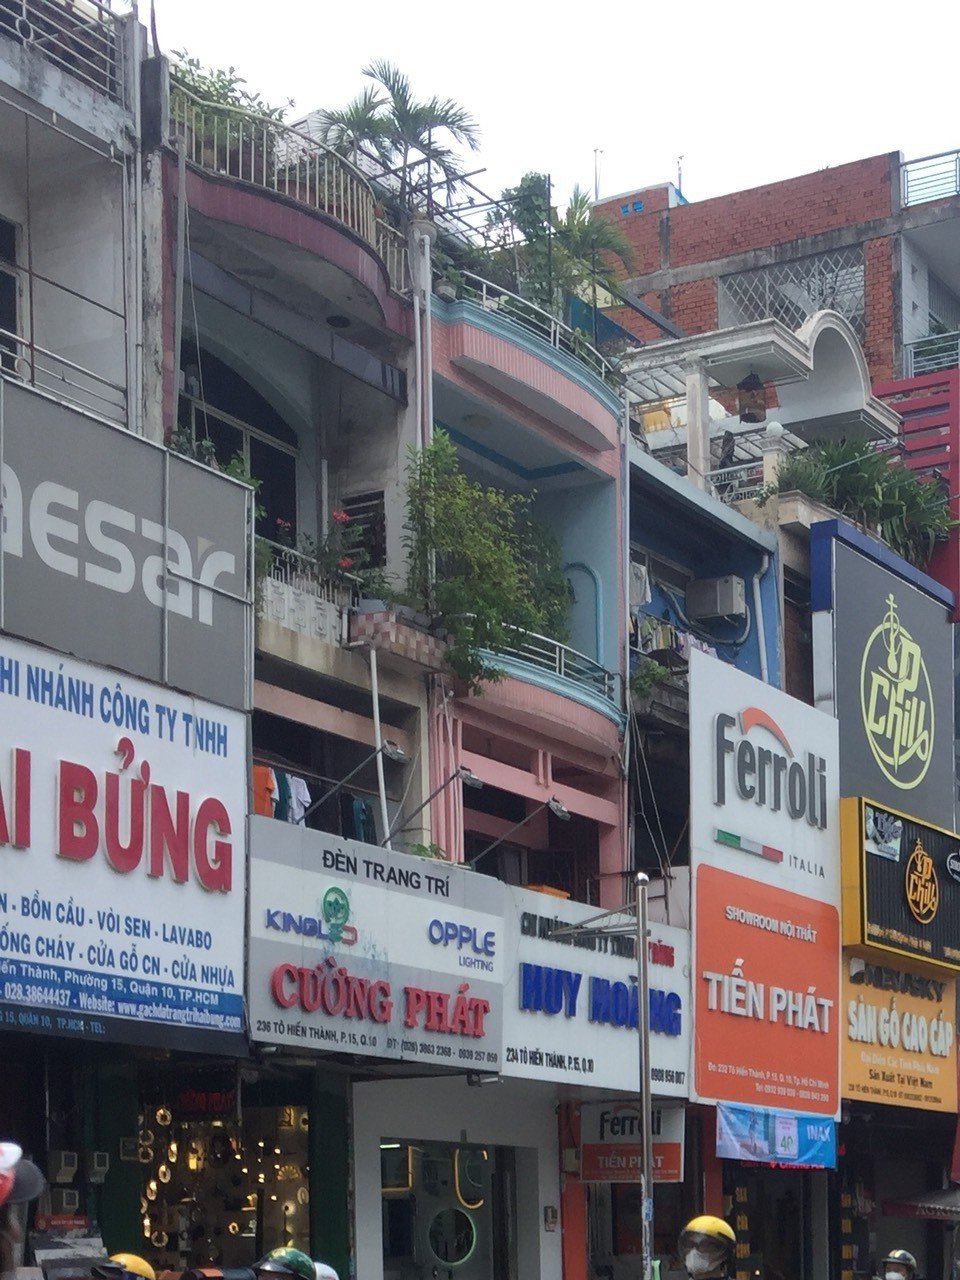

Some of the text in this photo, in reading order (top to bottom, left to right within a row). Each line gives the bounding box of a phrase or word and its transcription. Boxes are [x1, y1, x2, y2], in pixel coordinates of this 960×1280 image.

[27, 663, 94, 719] NHÁNH
[100, 683, 150, 735] CÔNG
[156, 704, 177, 742] TY
[183, 712, 228, 757] TNHH
[0, 737, 233, 892] I BỬNG
[322, 848, 450, 897] ĐÈN TRANG TRÍ
[789, 854, 825, 878] ITALIA
[21, 890, 52, 921] BỒN
[56, 896, 85, 927] CẦU
[98, 907, 120, 934] VÒI
[125, 915, 151, 939] SEN
[162, 923, 212, 950] LAVABO
[428, 918, 496, 957] OPPLE
[725, 905, 779, 933] SHOWROOM
[21, 963, 60, 983] Thành,
[64, 970, 108, 992] Phường
[111, 978, 127, 993] 15,
[130, 980, 159, 998] Quận
[162, 986, 176, 1001] 10,
[179, 988, 219, 1006] TP.HCM
[35, 934, 75, 962] CHÁY
[87, 939, 115, 969] CỬA
[120, 942, 139, 973] GỖ
[142, 954, 160, 976] CN
[172, 954, 198, 982] CỬA
[201, 964, 235, 992] NHỰA
[458, 955, 494, 972] LIGHTING
[79, 991, 115, 1013] Website:
[271, 955, 491, 1038] CƯỜNG PHÁT
[518, 961, 582, 1018] HUY
[702, 957, 834, 1034] TIẾN PHÁT
[902, 1012, 928, 1053] CAO
[806, 1124, 831, 1142] INAX
